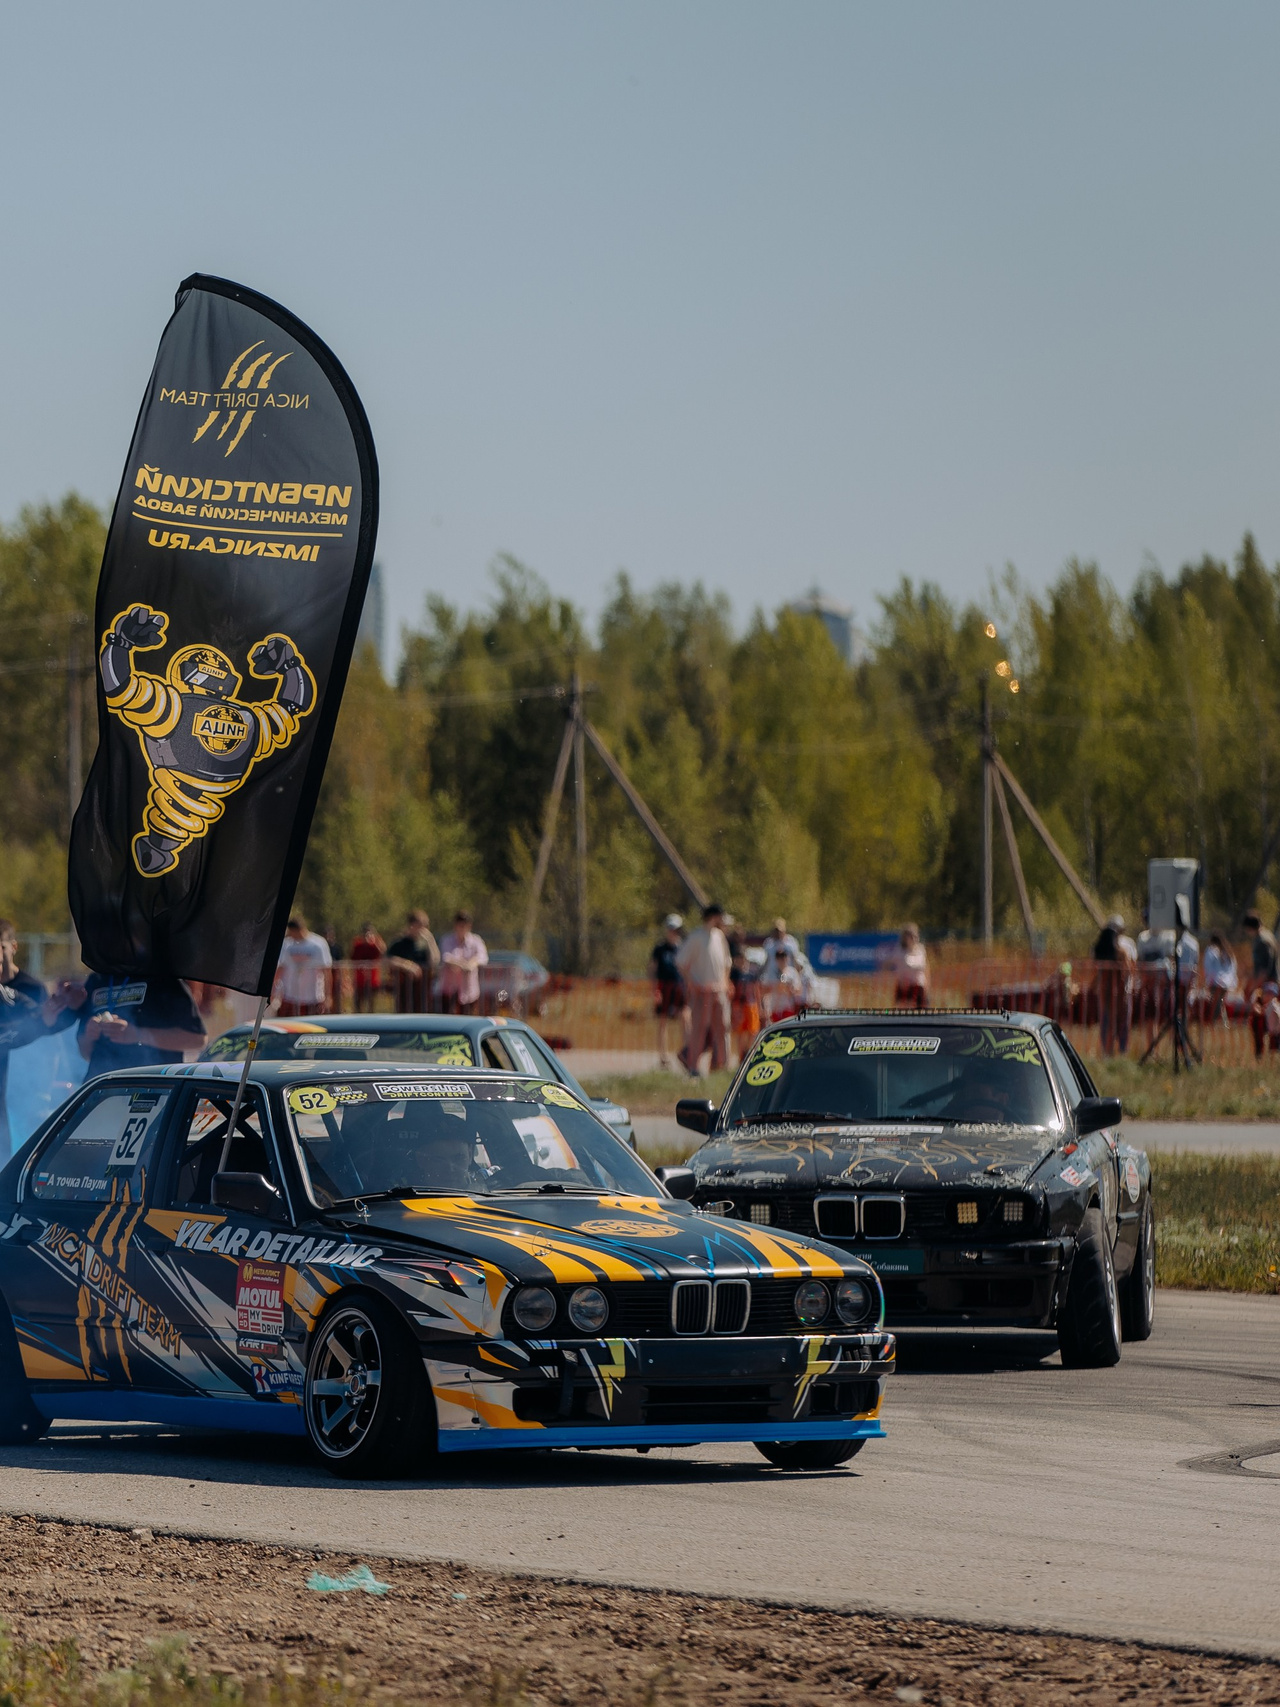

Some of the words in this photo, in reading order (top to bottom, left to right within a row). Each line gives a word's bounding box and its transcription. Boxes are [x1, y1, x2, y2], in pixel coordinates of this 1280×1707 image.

[752, 1065, 775, 1081] 35
[378, 1084, 470, 1094] POWERSLIDE
[298, 1092, 328, 1110] 52
[115, 1117, 148, 1159] 52
[56, 1176, 81, 1188] точка
[80, 1175, 108, 1191] Паули
[174, 1219, 250, 1256] VILAR
[43, 1222, 87, 1272] NICA
[87, 1252, 137, 1312] DRIFT
[136, 1294, 183, 1358] TEAM
[238, 1286, 282, 1309] MOTUL
[250, 1309, 261, 1320] MY
[261, 1323, 283, 1335] DRIVE
